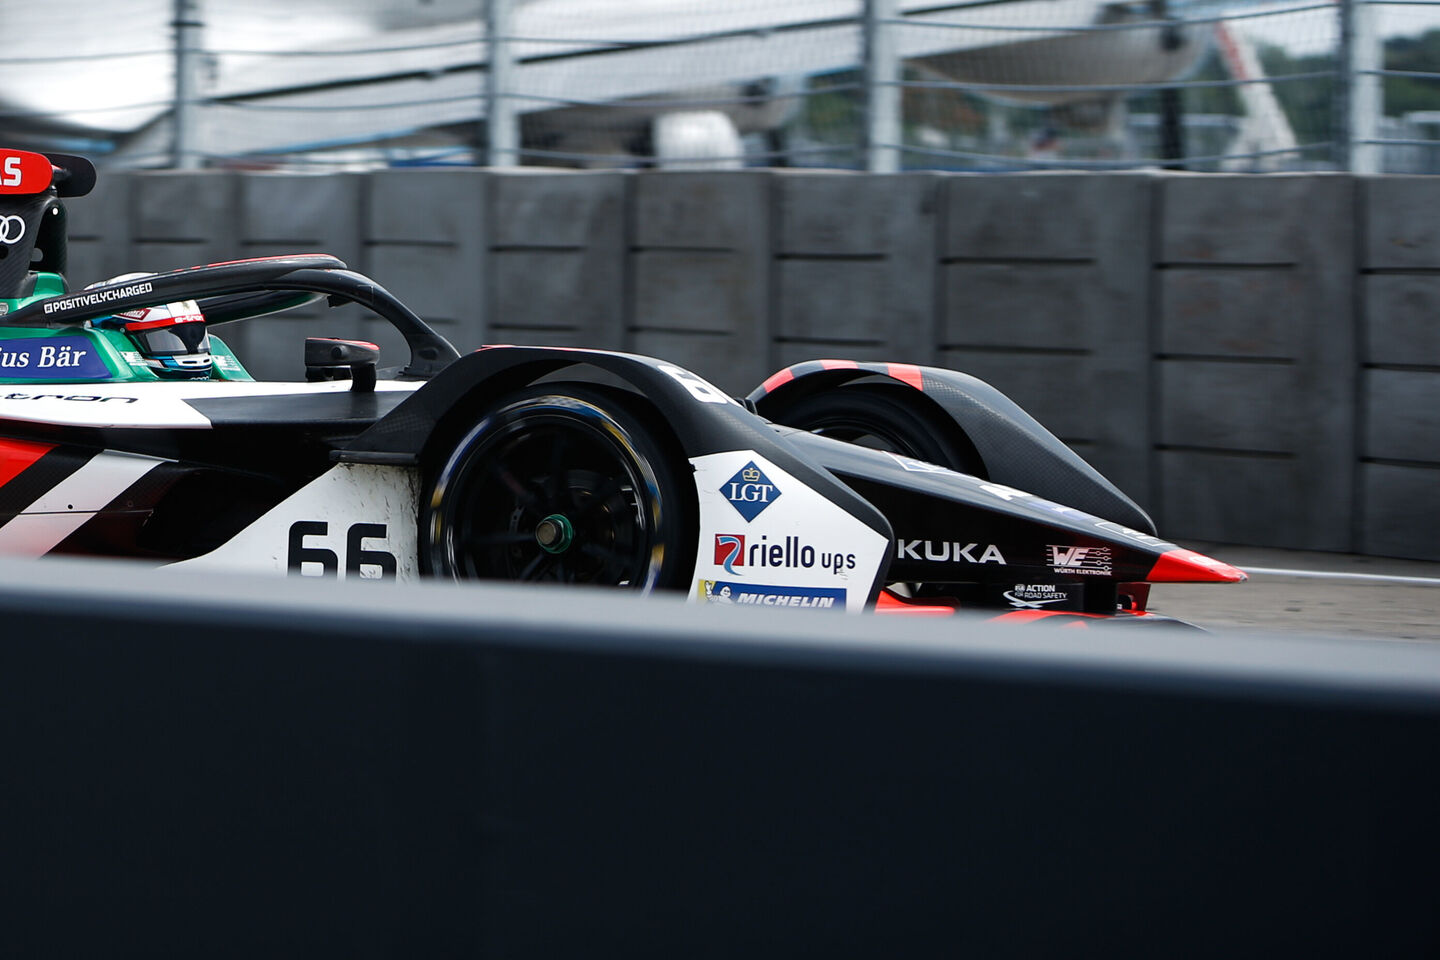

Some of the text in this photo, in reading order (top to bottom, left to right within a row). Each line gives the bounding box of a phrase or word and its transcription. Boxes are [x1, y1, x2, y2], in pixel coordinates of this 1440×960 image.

[36, 345, 87, 369] Bär
[729, 482, 774, 503] LGT
[287, 520, 397, 578] 66
[748, 534, 857, 575] riello ups
[897, 538, 1007, 565] KUKA
[1026, 584, 1056, 592] ACTION
[736, 592, 836, 609] MICHELIN
